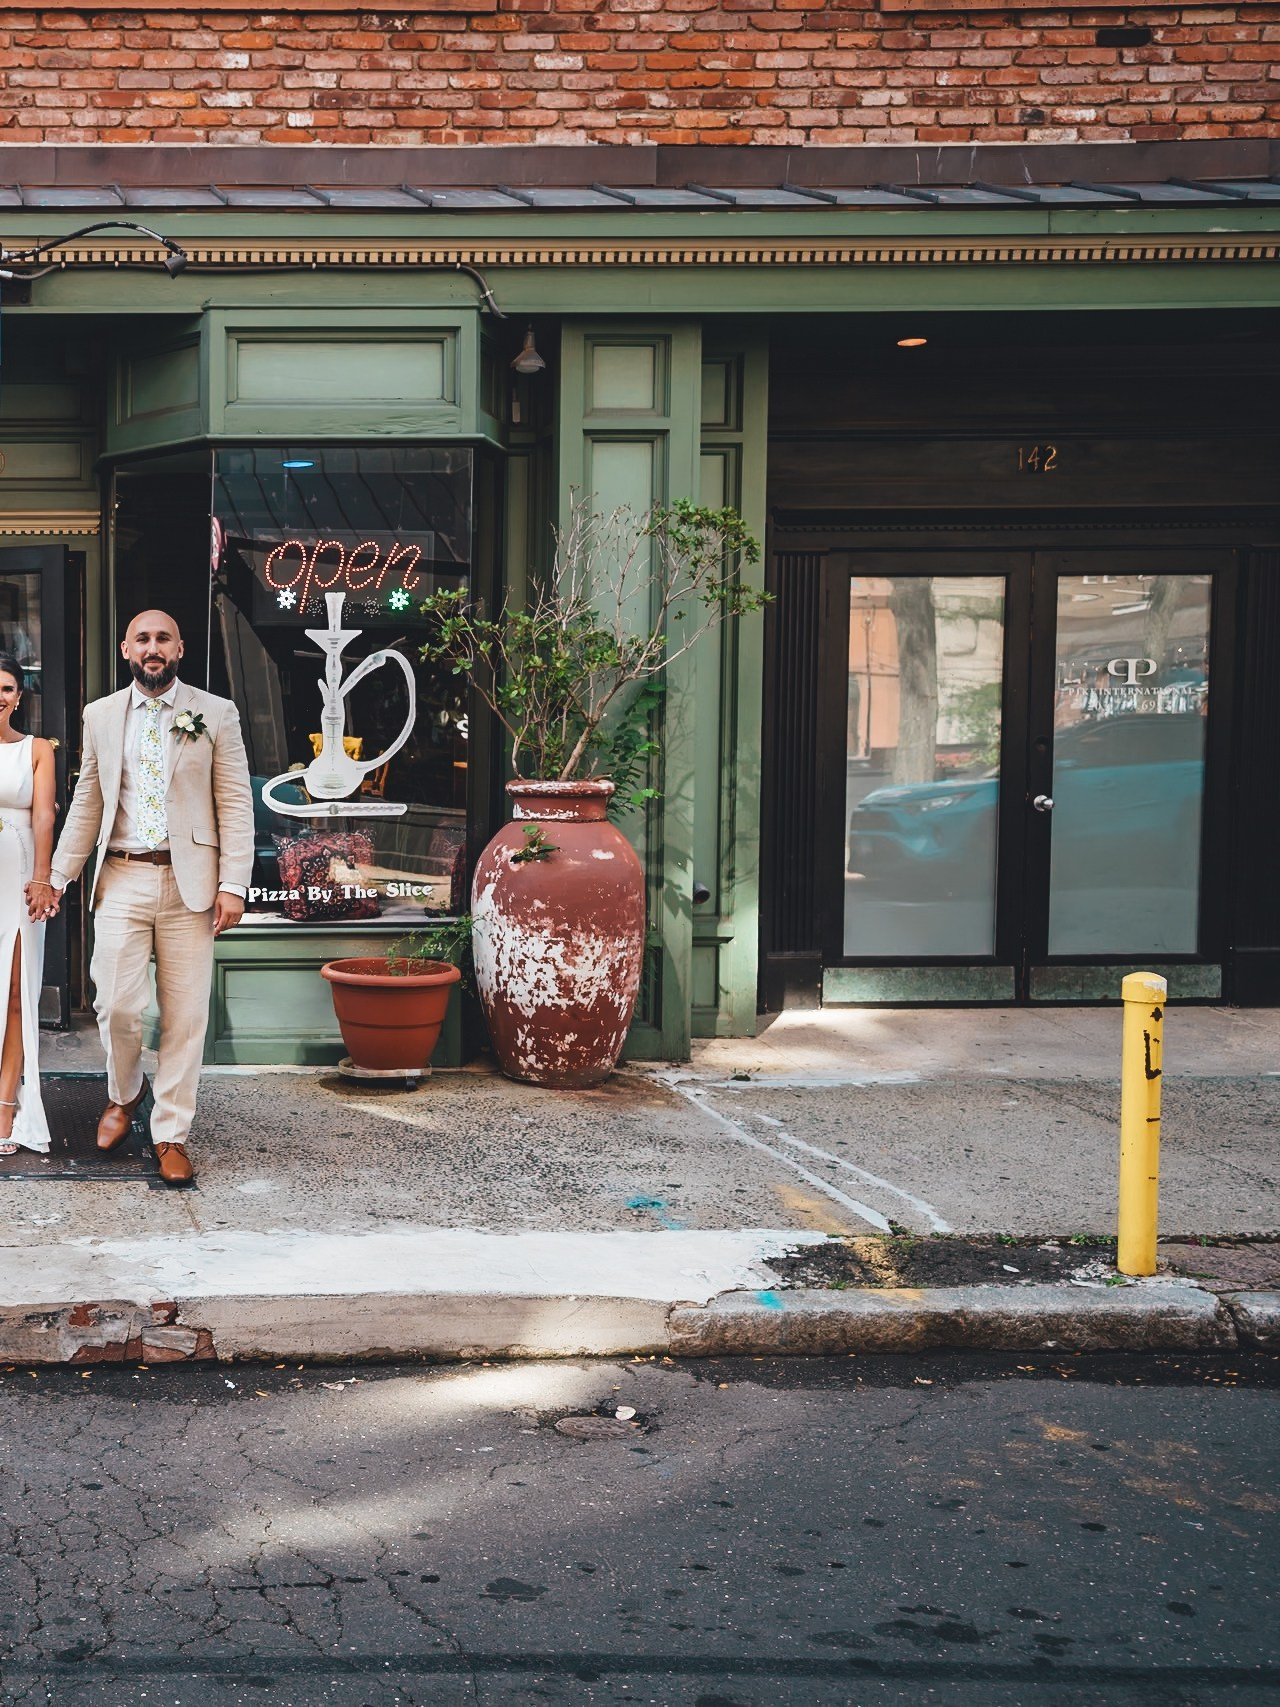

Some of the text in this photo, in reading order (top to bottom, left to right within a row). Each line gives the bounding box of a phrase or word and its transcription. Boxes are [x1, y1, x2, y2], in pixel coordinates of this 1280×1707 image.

[1018, 445, 1057, 471] 142
[265, 540, 421, 614] open
[248, 882, 433, 903] Pizza By The Slice
